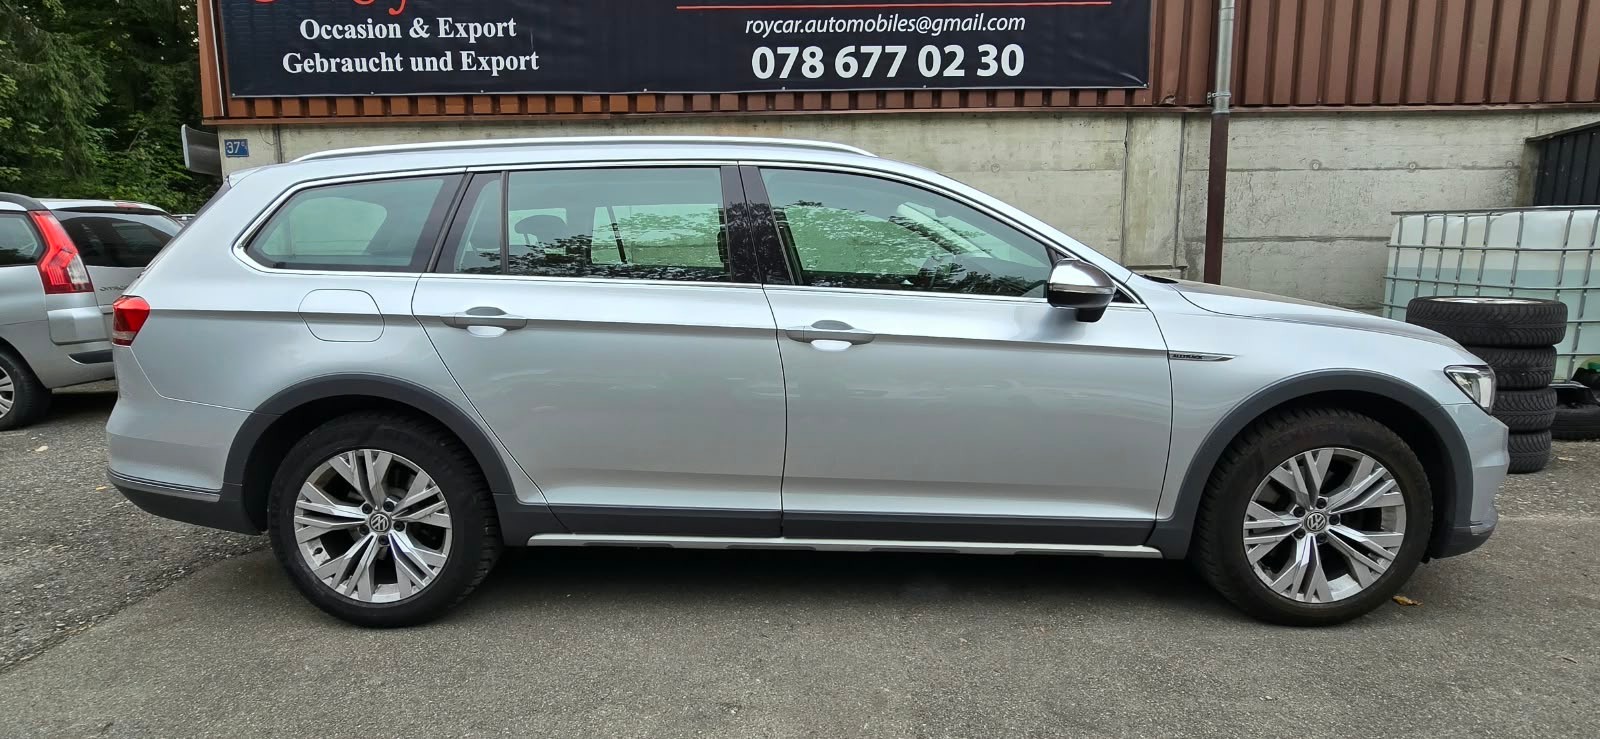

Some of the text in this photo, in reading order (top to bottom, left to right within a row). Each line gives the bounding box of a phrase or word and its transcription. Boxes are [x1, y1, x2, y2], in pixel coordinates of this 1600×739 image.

[300, 17, 516, 43] Occasion & Export
[745, 13, 1026, 37] roycar.automobiles@gmail.com
[283, 51, 539, 76] Gebraucht und Export
[751, 44, 1024, 79] 078 677 02 30
